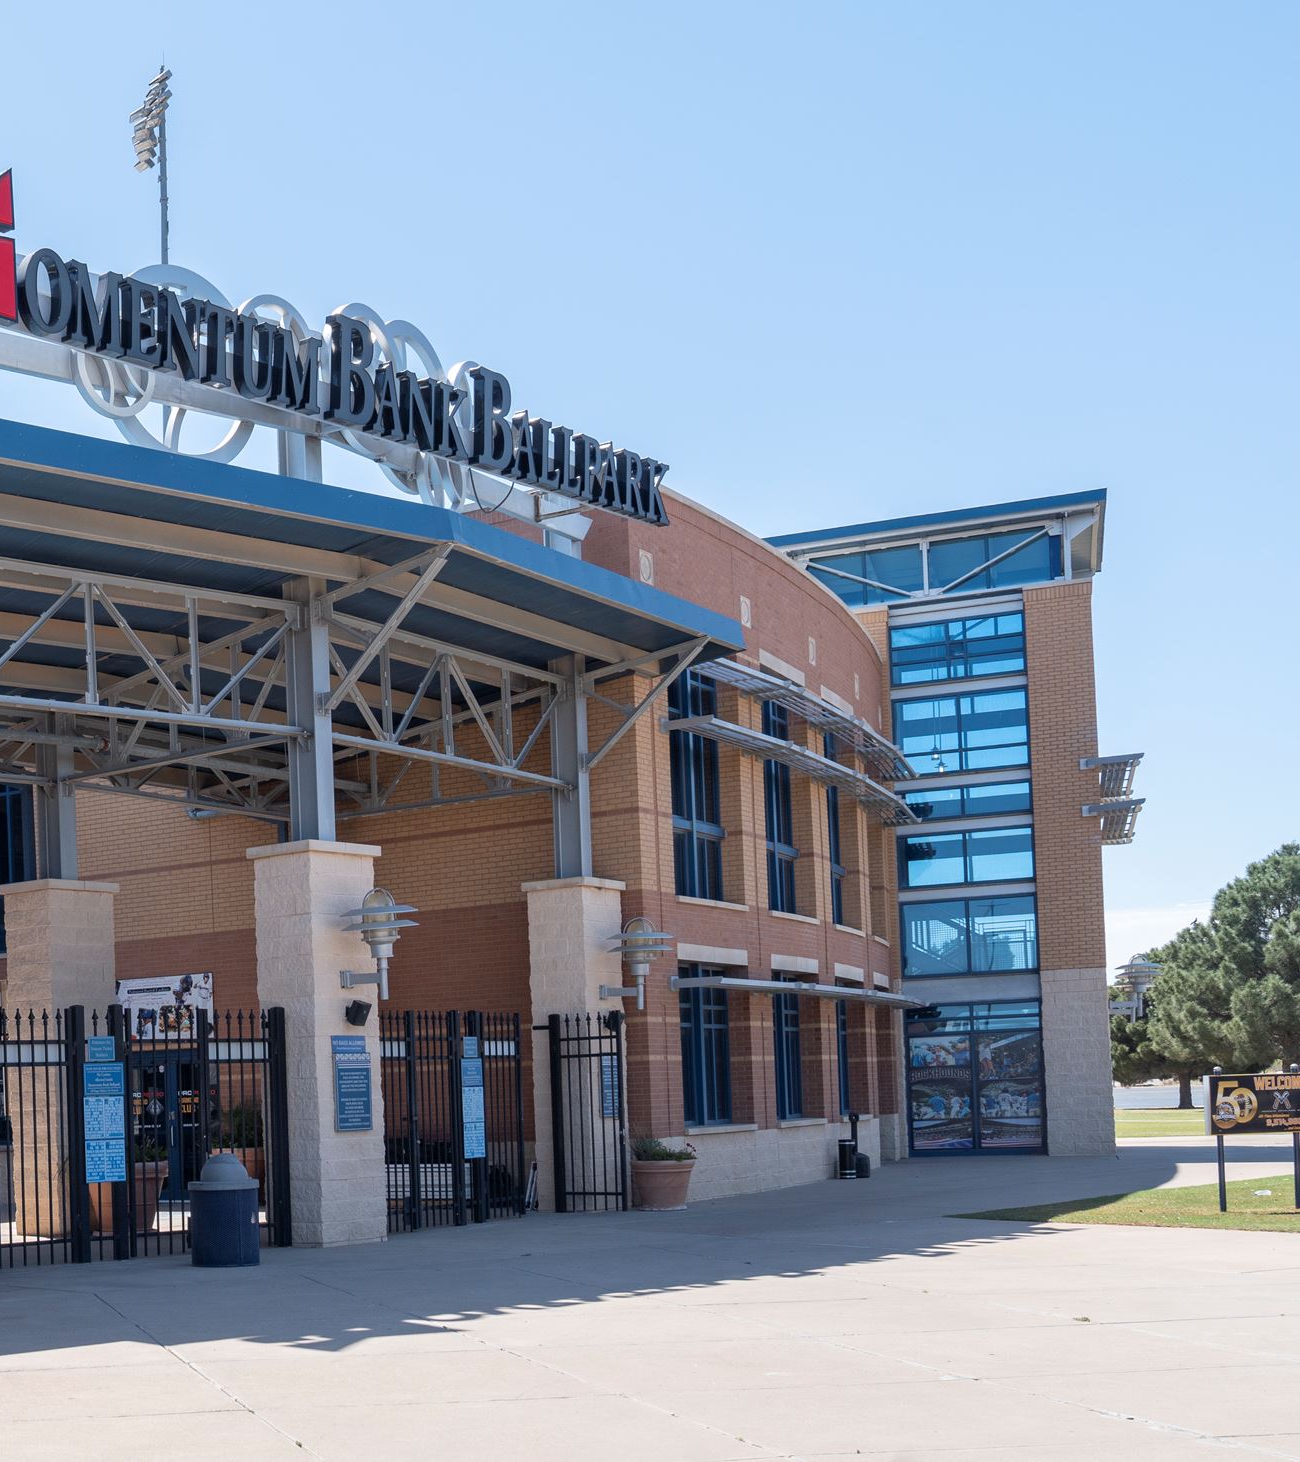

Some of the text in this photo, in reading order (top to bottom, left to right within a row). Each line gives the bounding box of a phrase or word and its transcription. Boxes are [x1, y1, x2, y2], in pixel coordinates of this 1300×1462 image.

[324, 314, 469, 461] BANK
[469, 366, 671, 527] BALLPARK
[1212, 1081, 1258, 1129] 50
